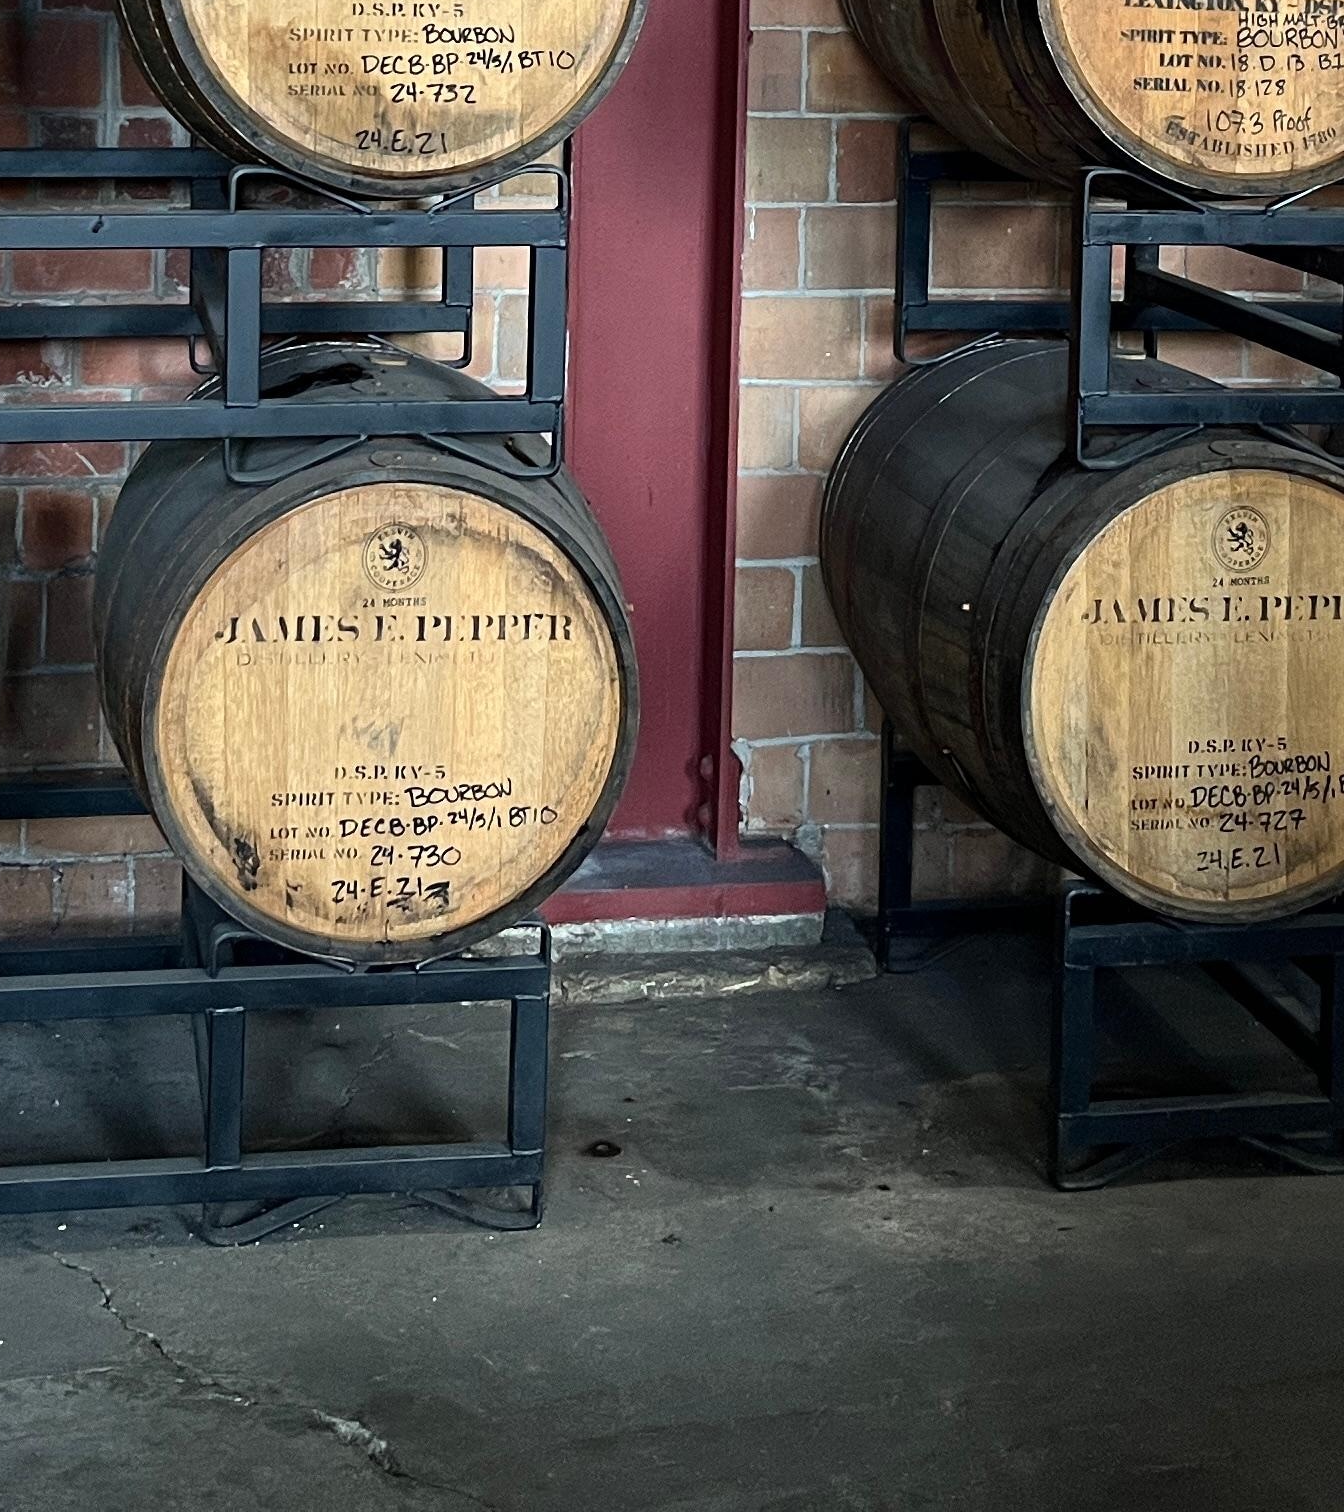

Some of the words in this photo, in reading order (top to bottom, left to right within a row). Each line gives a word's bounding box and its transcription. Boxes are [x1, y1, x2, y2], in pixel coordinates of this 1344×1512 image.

[1238, 11, 1279, 27] HIGH
[288, 27, 354, 42] SPIRIT
[362, 28, 419, 44] TYPE:
[422, 24, 515, 45] BOURBON
[1120, 29, 1176, 44] SPIRIT
[1179, 31, 1228, 45] TYPE:
[1236, 27, 1339, 49] BOURBON
[288, 62, 318, 75] LOT
[1159, 53, 1193, 68] LOT
[1197, 53, 1226, 70] NO.
[287, 84, 346, 97] SERIAL
[1133, 77, 1192, 92] SERIAL
[1272, 106, 1313, 133] Proof
[1165, 121, 1296, 157] ESTABLISHED
[1303, 127, 1337, 151] 1780
[1080, 596, 1210, 625] JAMES
[214, 615, 361, 644] JAMES
[415, 613, 573, 642] PEPPER
[1132, 764, 1190, 780] SPIRIT
[1248, 751, 1331, 779] BOURBON
[271, 791, 335, 807] SPIRIT
[342, 792, 401, 807] TYPE:
[404, 778, 512, 808] BOURBON
[269, 826, 299, 840] LOT
[269, 848, 326, 862] SERIAL
